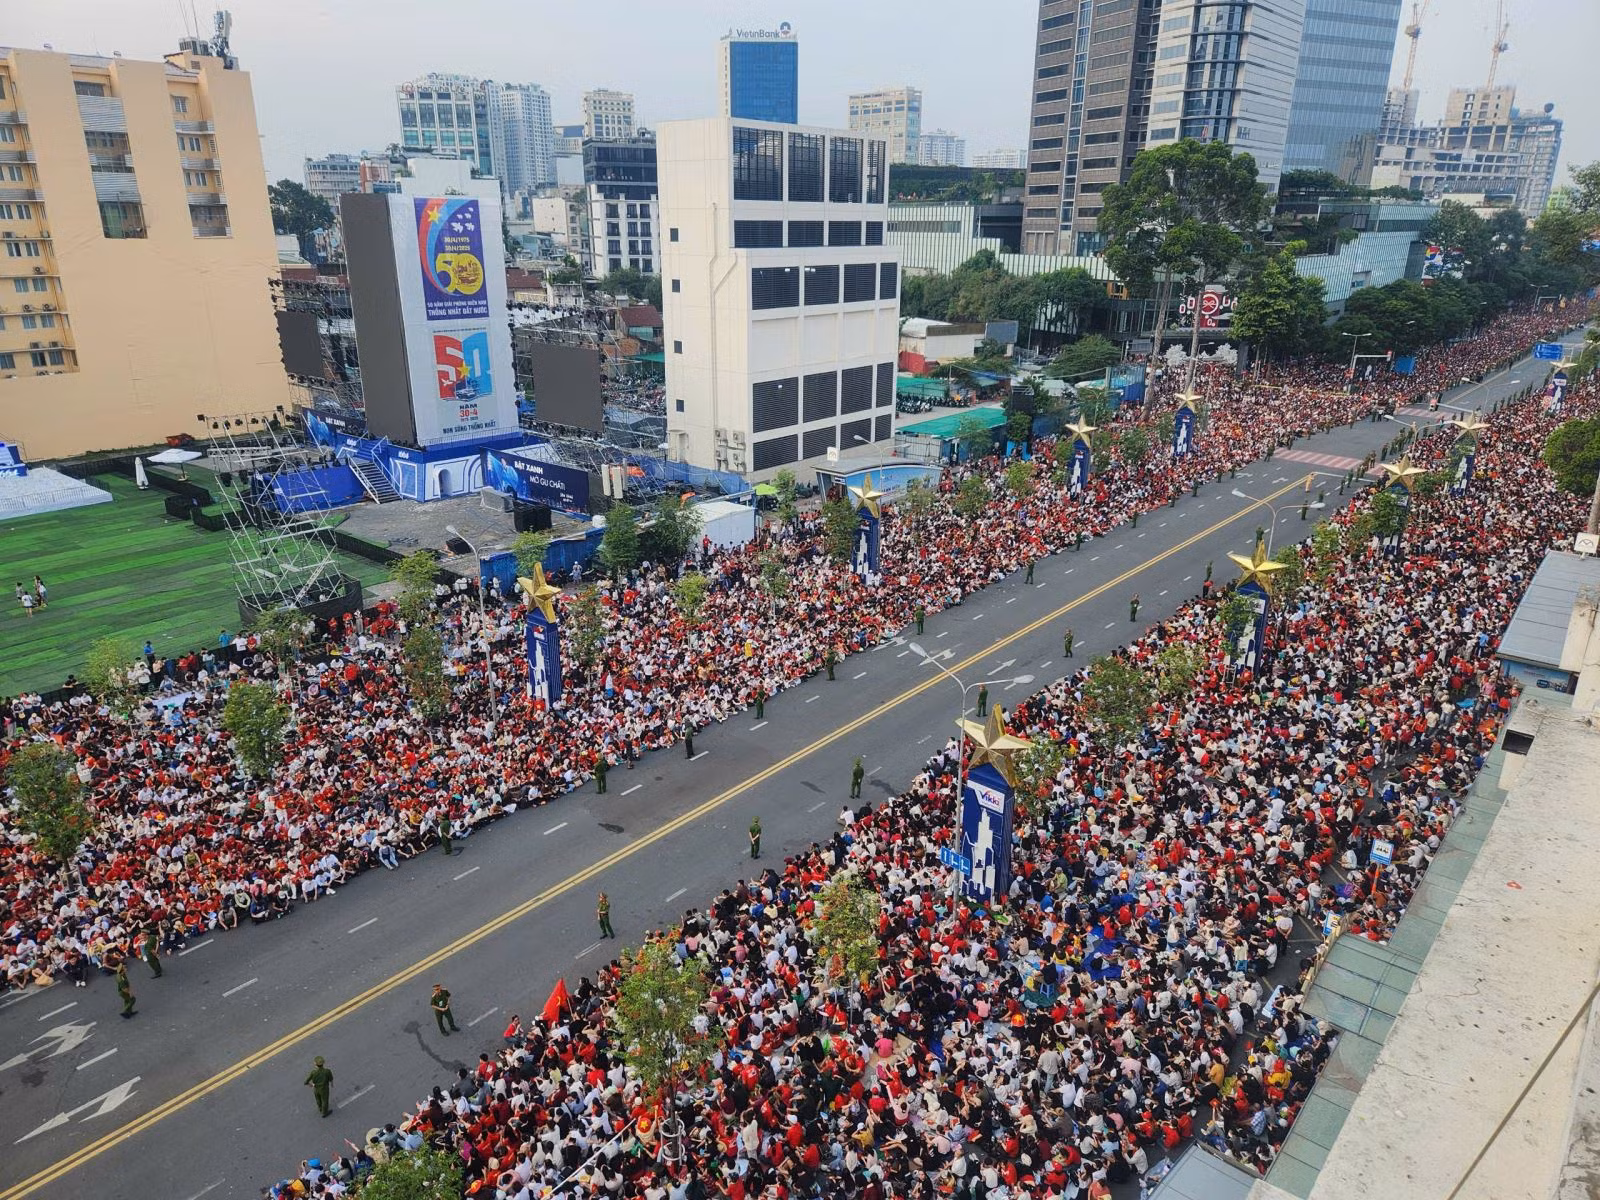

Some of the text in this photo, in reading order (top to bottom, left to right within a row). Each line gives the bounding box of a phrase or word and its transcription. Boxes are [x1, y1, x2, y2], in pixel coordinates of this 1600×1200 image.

[736, 29, 780, 38] VietinBank
[526, 464, 543, 474] XANH
[540, 478, 549, 487] GU
